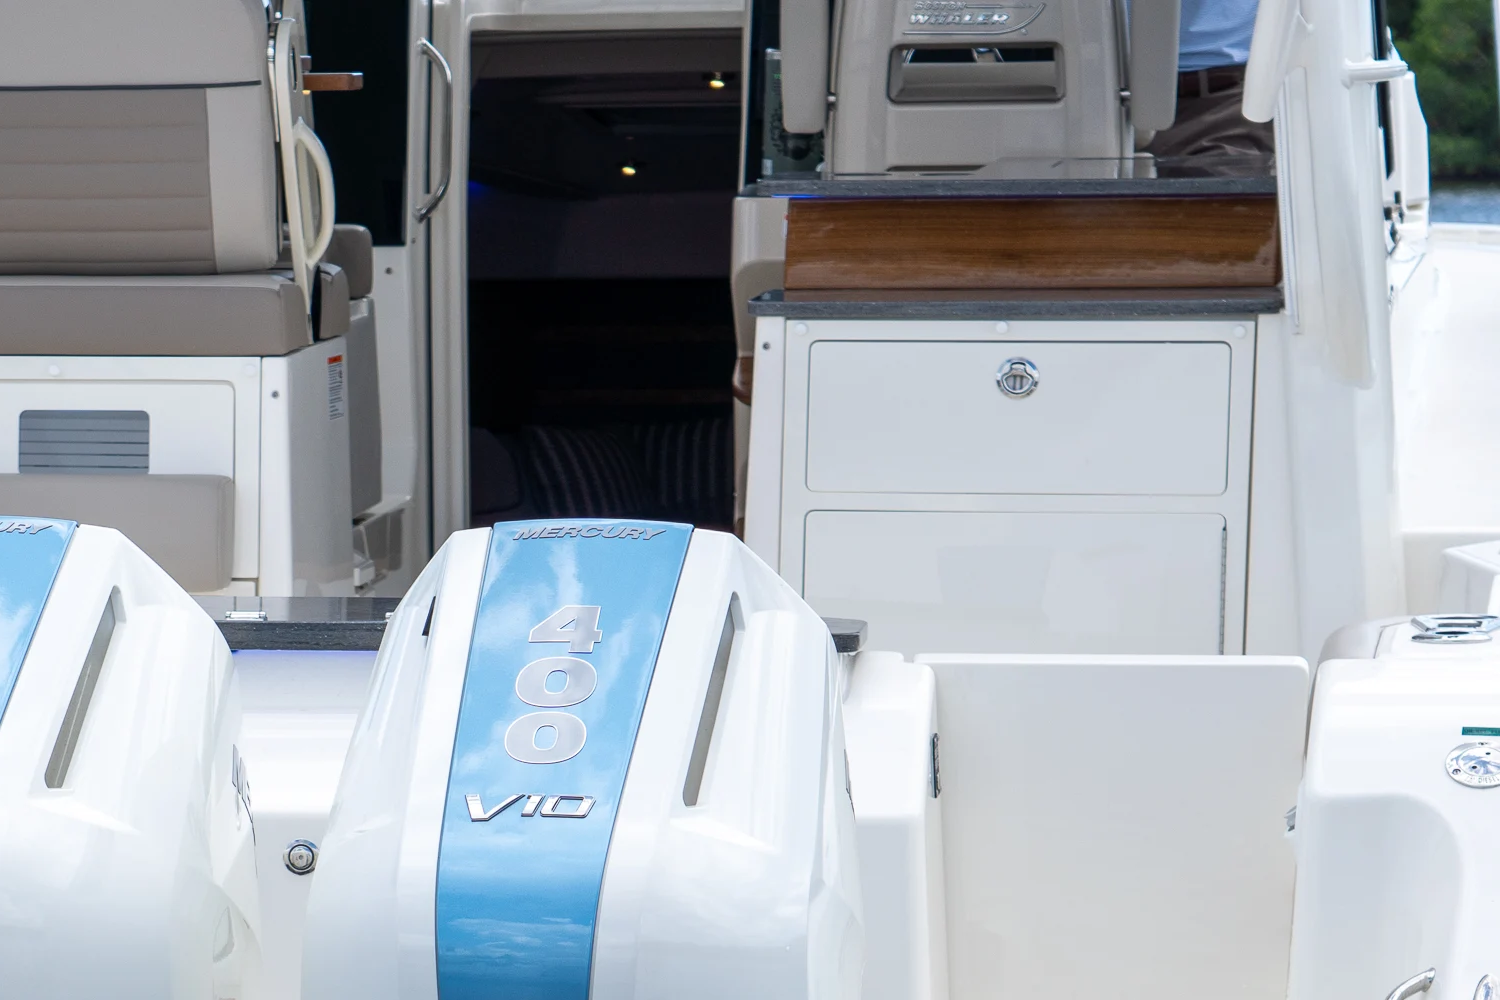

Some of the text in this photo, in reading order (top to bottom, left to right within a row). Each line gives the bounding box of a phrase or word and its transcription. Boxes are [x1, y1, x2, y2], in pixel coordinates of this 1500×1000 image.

[909, 12, 1010, 25] WHALER
[512, 526, 667, 540] MERCURY
[504, 605, 602, 764] 400
[465, 794, 597, 822] V10
